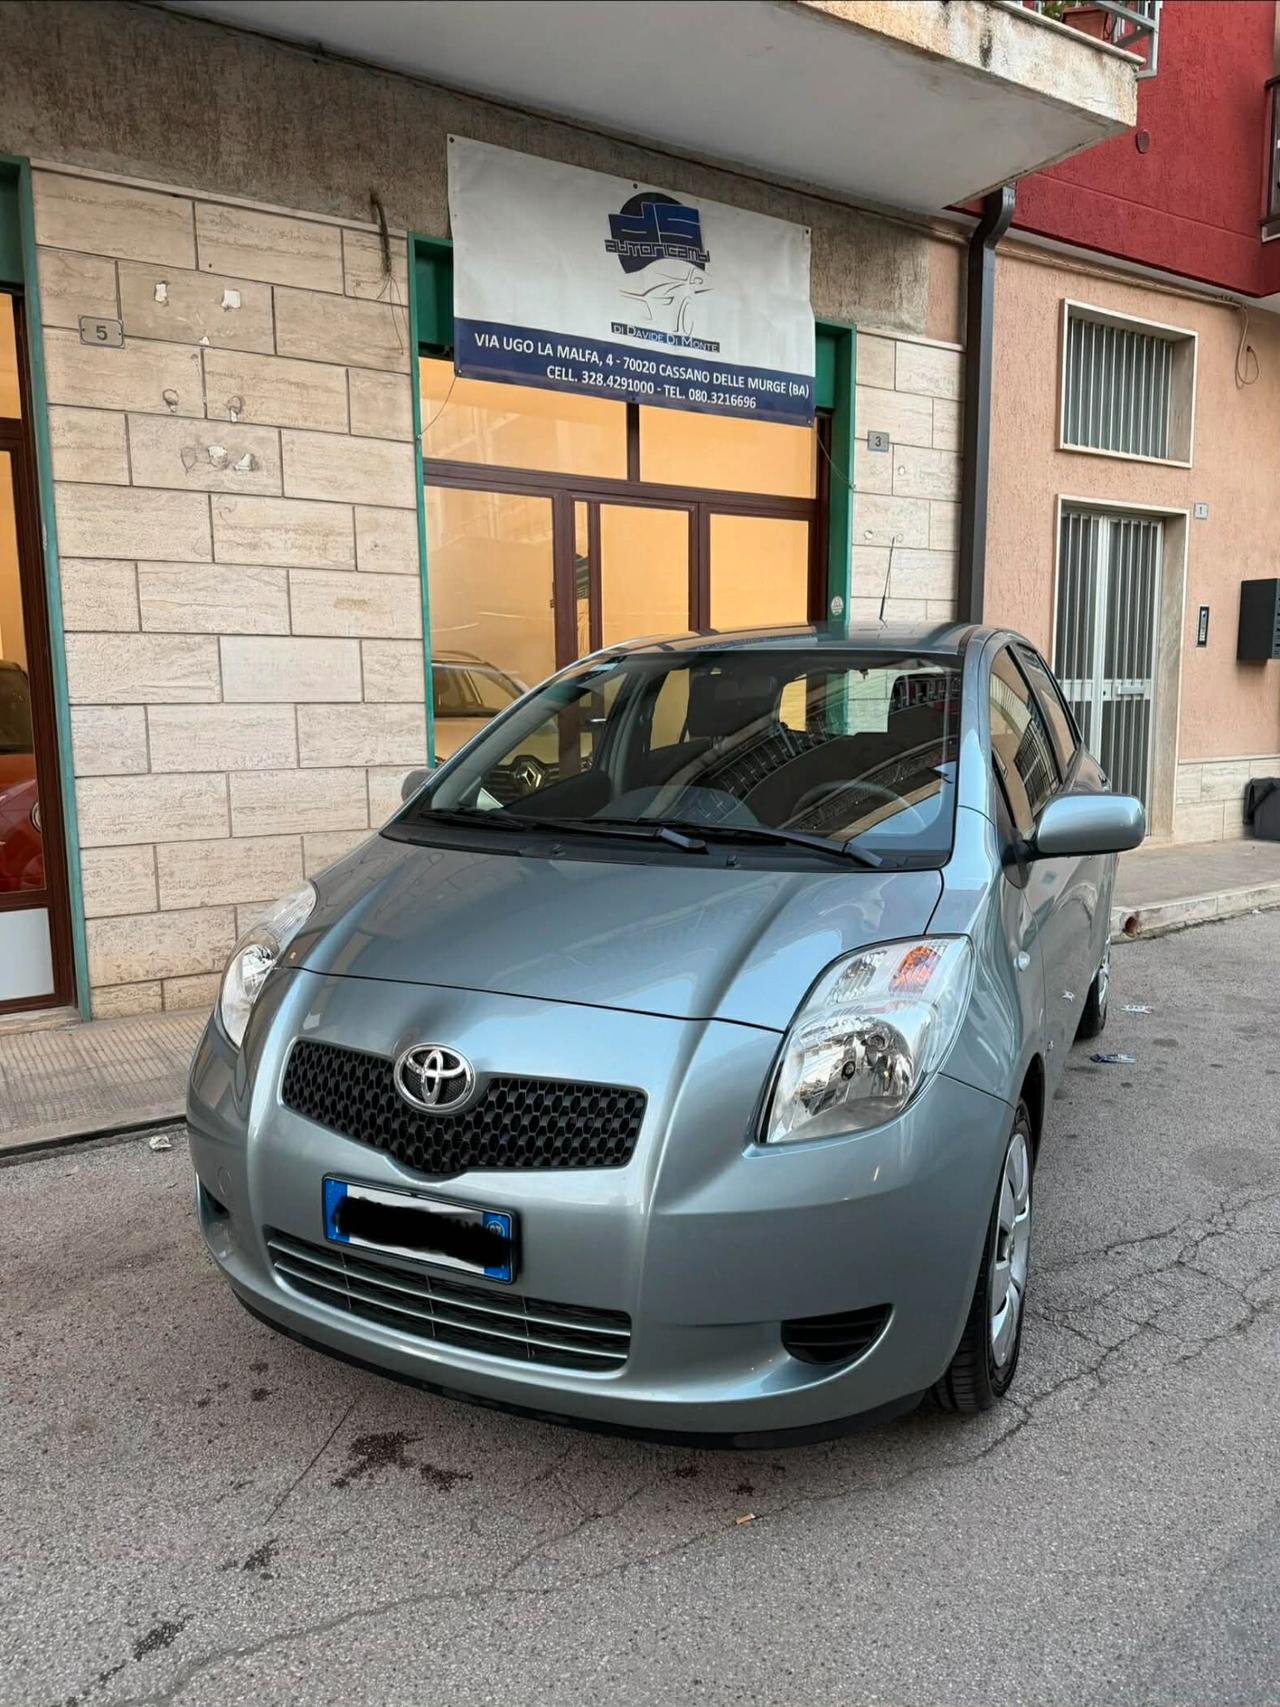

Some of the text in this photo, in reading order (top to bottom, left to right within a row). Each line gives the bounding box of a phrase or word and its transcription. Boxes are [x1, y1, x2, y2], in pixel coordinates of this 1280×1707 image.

[96, 325, 108, 341] 5
[681, 336, 718, 353] MONTE
[474, 333, 499, 349] VIA
[503, 337, 534, 353] UGO
[538, 342, 553, 357] LA
[557, 345, 603, 367] MALFA,
[605, 353, 614, 366] 4
[623, 357, 657, 375] 70020
[659, 363, 710, 383] CASSANO
[713, 373, 745, 388] DELLE
[748, 377, 786, 394] MURGE
[788, 381, 810, 399] (BA)
[546, 365, 578, 382] CELL.
[581, 371, 654, 395] 328.4291000
[663, 384, 686, 399] TEL.
[688, 388, 757, 408] 080.3216696
[875, 435, 882, 448] 3
